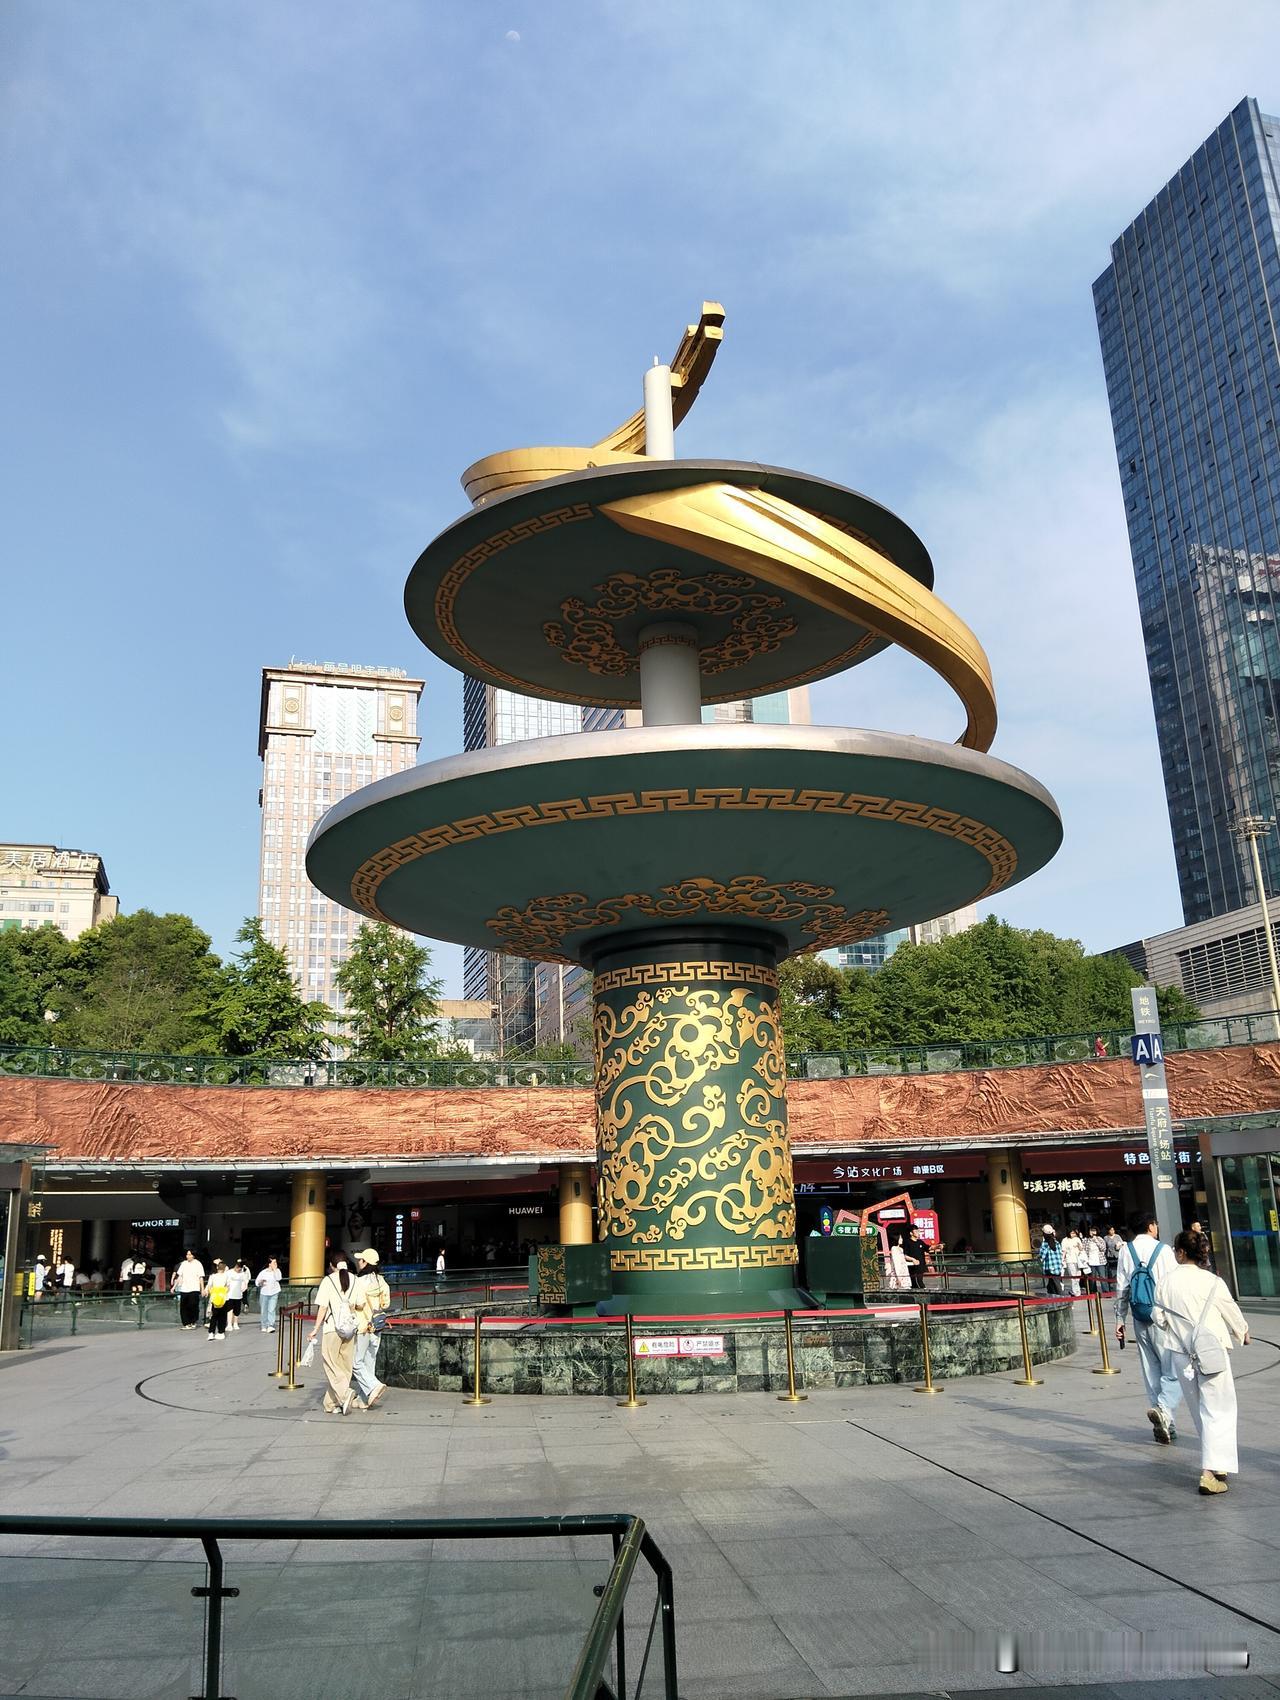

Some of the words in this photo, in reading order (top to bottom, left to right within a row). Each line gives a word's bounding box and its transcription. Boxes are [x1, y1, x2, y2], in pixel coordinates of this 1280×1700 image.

[5, 851, 94, 869] 美居酒店
[1139, 995, 1151, 1016] 地铁
[1136, 1039, 1150, 1061] A
[1154, 1038, 1162, 1060] A
[1155, 1106, 1171, 1161] 天府广场站
[508, 1206, 543, 1215] HUAWEI
[131, 1219, 164, 1228] HONOR
